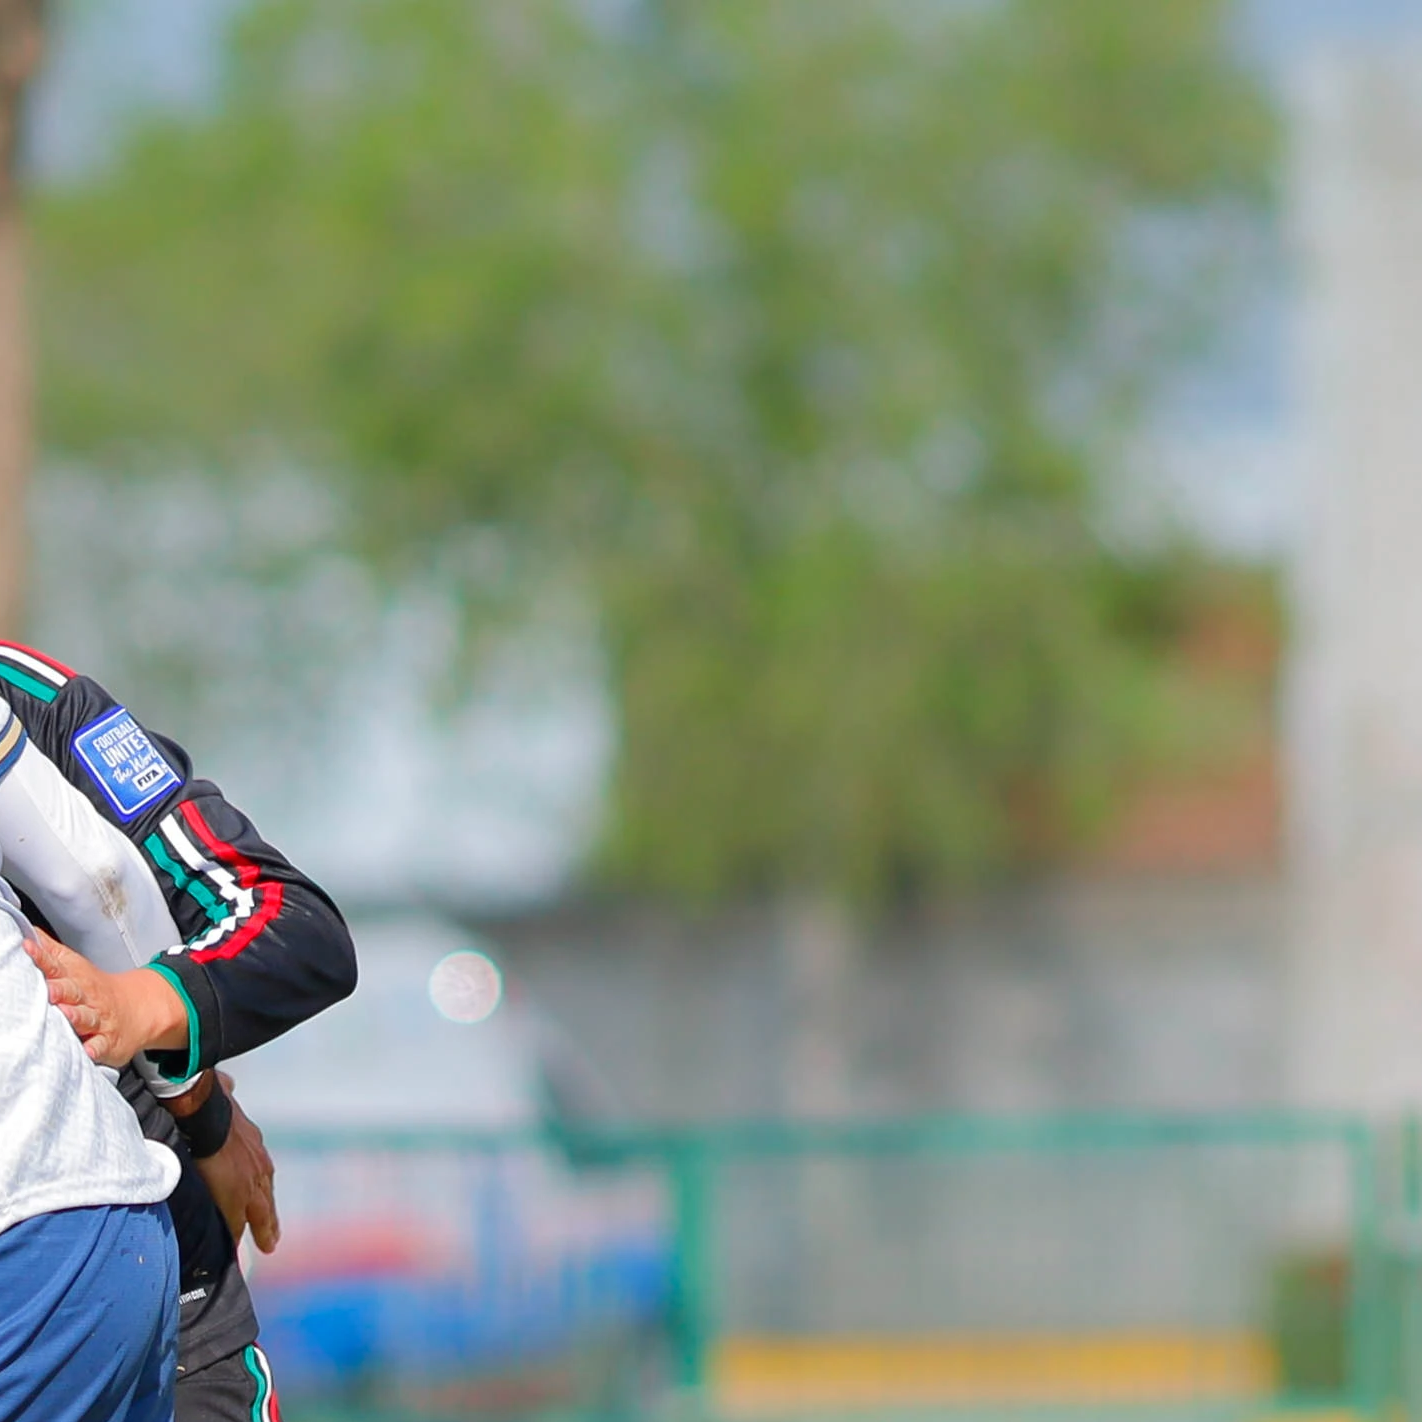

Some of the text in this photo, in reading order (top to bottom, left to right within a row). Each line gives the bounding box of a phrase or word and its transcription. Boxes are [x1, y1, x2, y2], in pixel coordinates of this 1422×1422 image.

[93, 717, 138, 752] FOOTBALL
[101, 728, 150, 768] UNITES
[112, 764, 134, 784] the
[137, 769, 160, 788] FIFA
